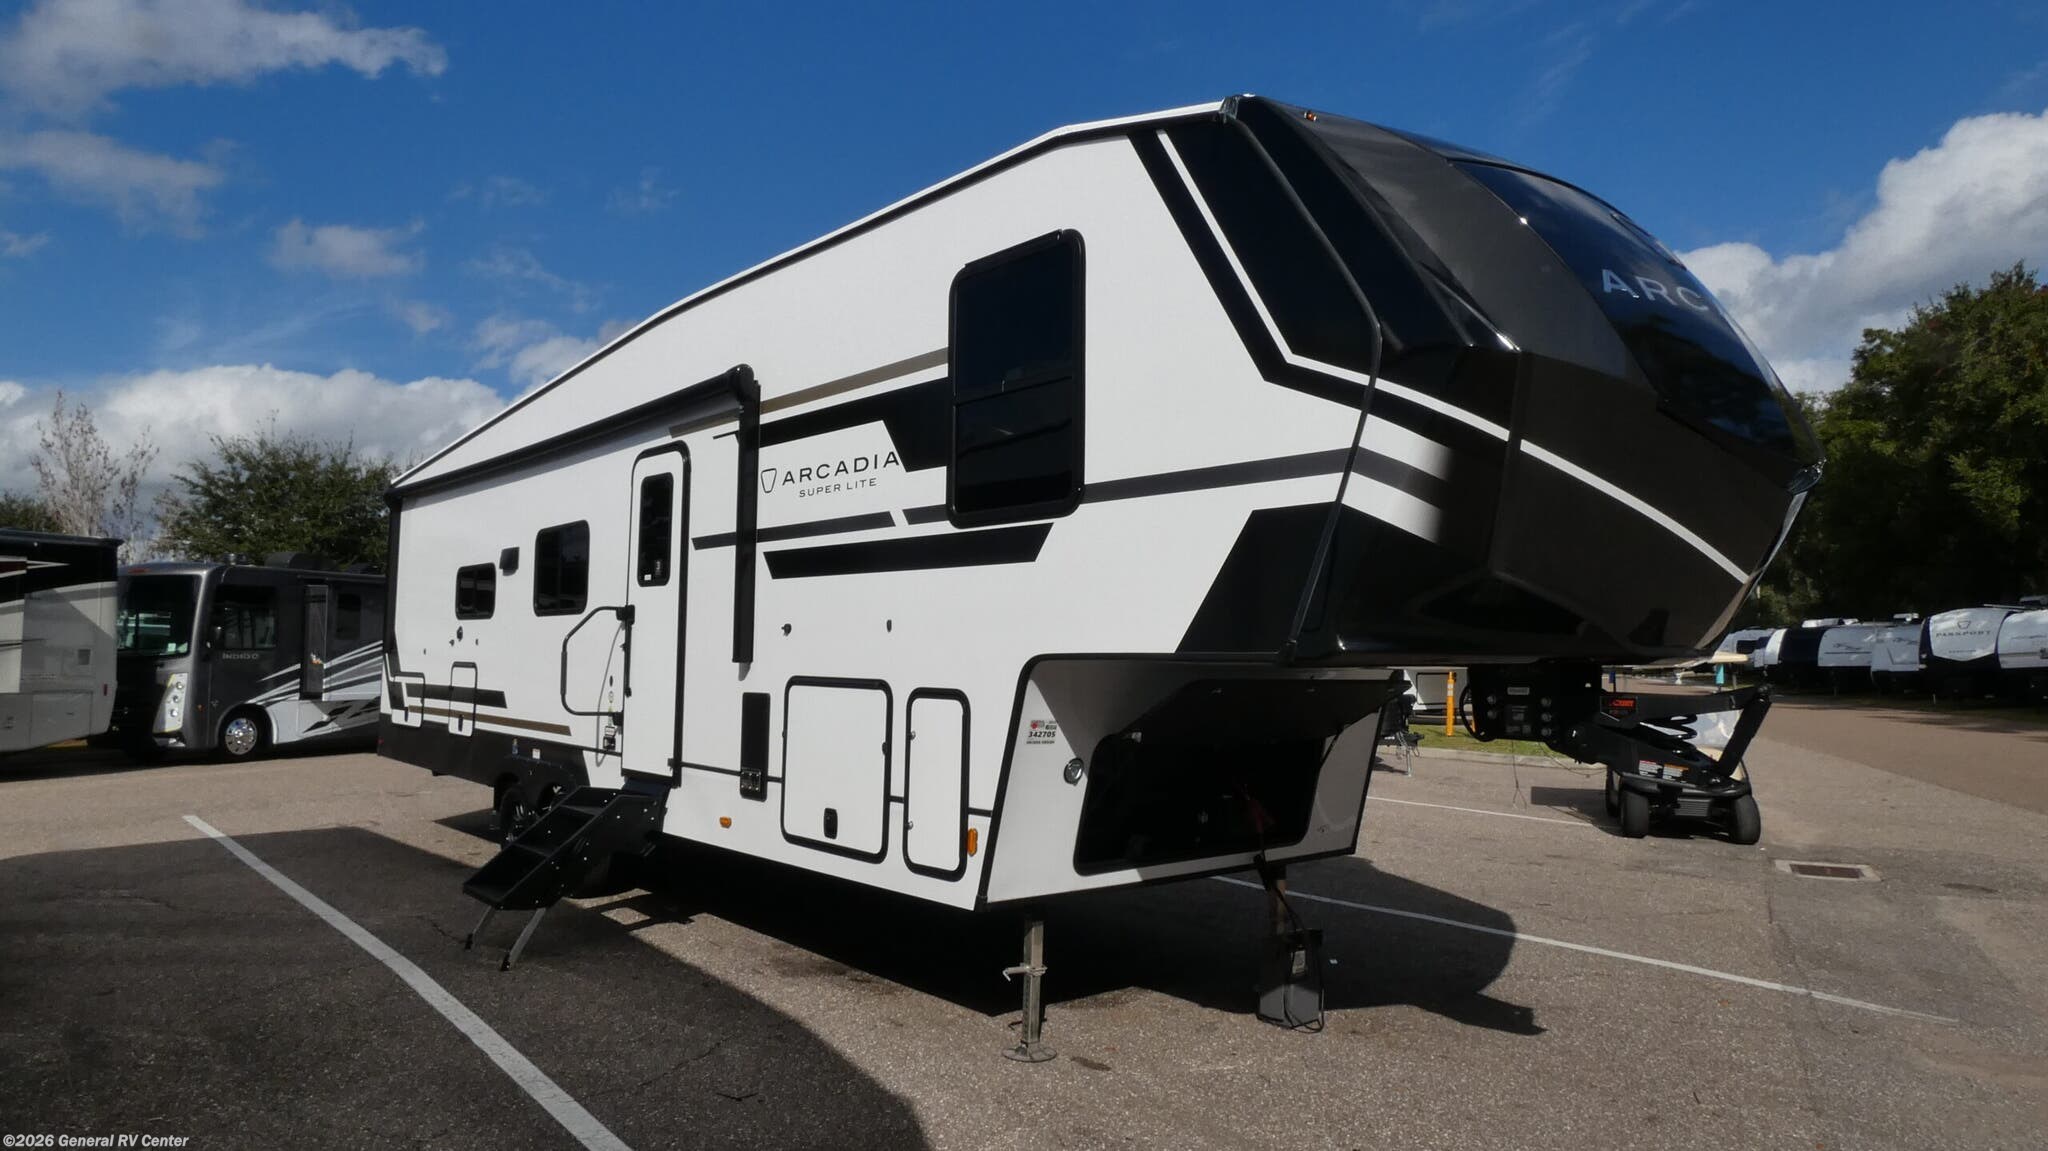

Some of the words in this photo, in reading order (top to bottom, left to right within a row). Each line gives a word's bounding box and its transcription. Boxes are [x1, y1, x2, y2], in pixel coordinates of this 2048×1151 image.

[782, 451, 899, 486] ARCADIA
[799, 484, 841, 498] SUPER
[846, 478, 877, 490] LITE
